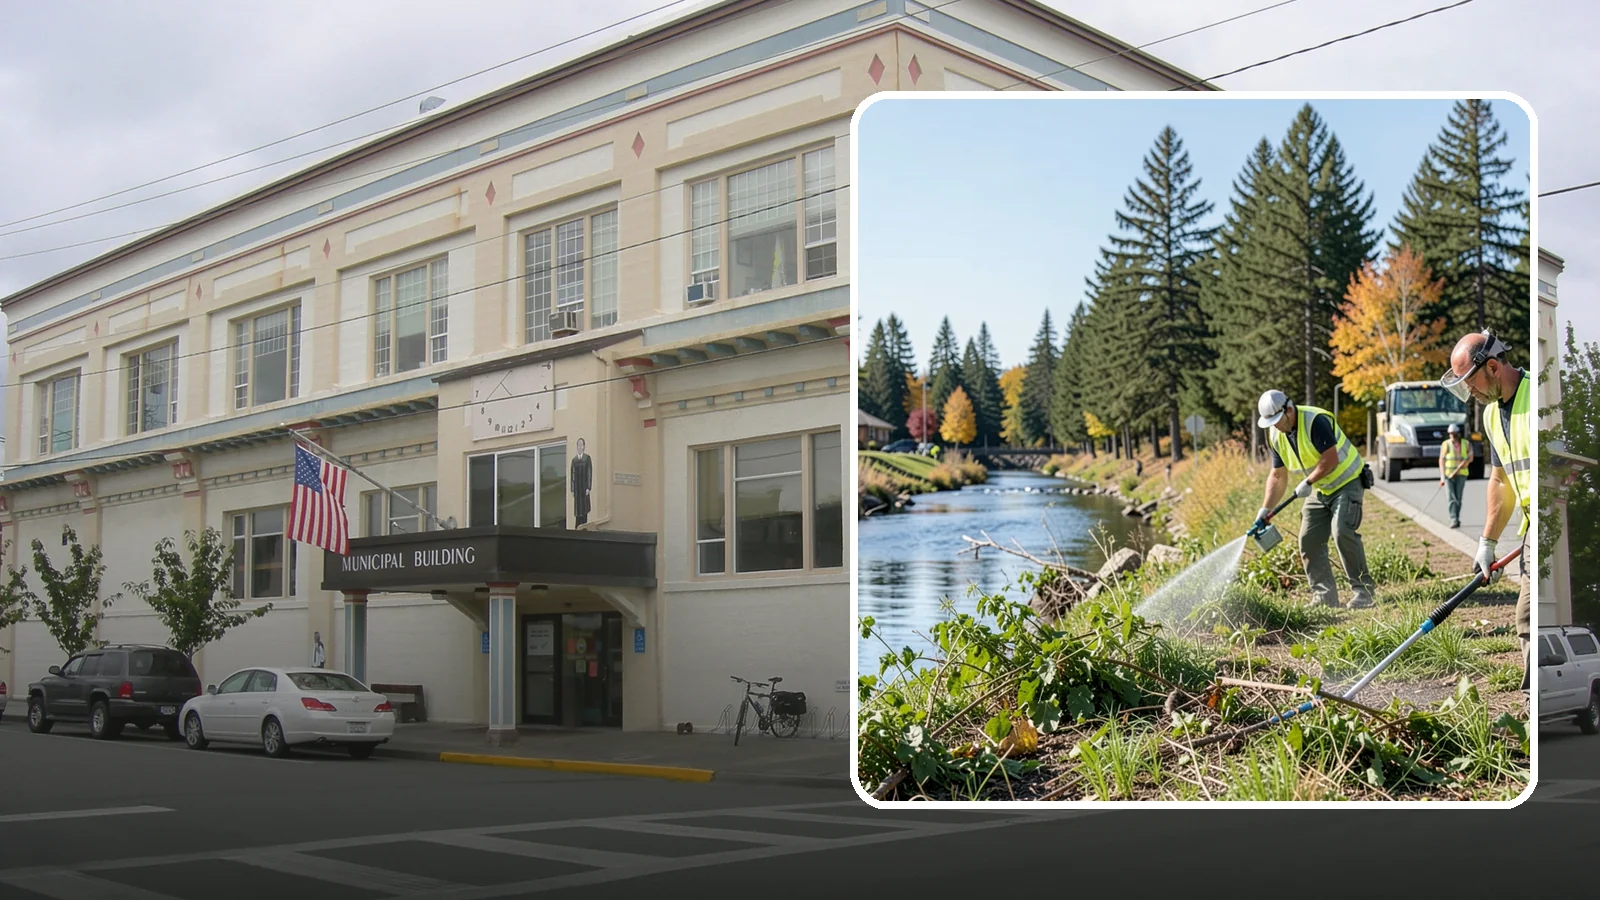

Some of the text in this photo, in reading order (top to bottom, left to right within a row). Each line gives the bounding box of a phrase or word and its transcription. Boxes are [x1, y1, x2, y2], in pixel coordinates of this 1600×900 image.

[475, 390, 479, 398] 7
[536, 402, 540, 410] 4
[481, 407, 485, 415] 8
[488, 417, 492, 426] 9
[529, 414, 533, 422] 3
[495, 423, 500, 431] 10
[521, 420, 526, 428] 2
[507, 425, 513, 433] 12
[342, 546, 475, 572] MUNICIPAL BUILDING
